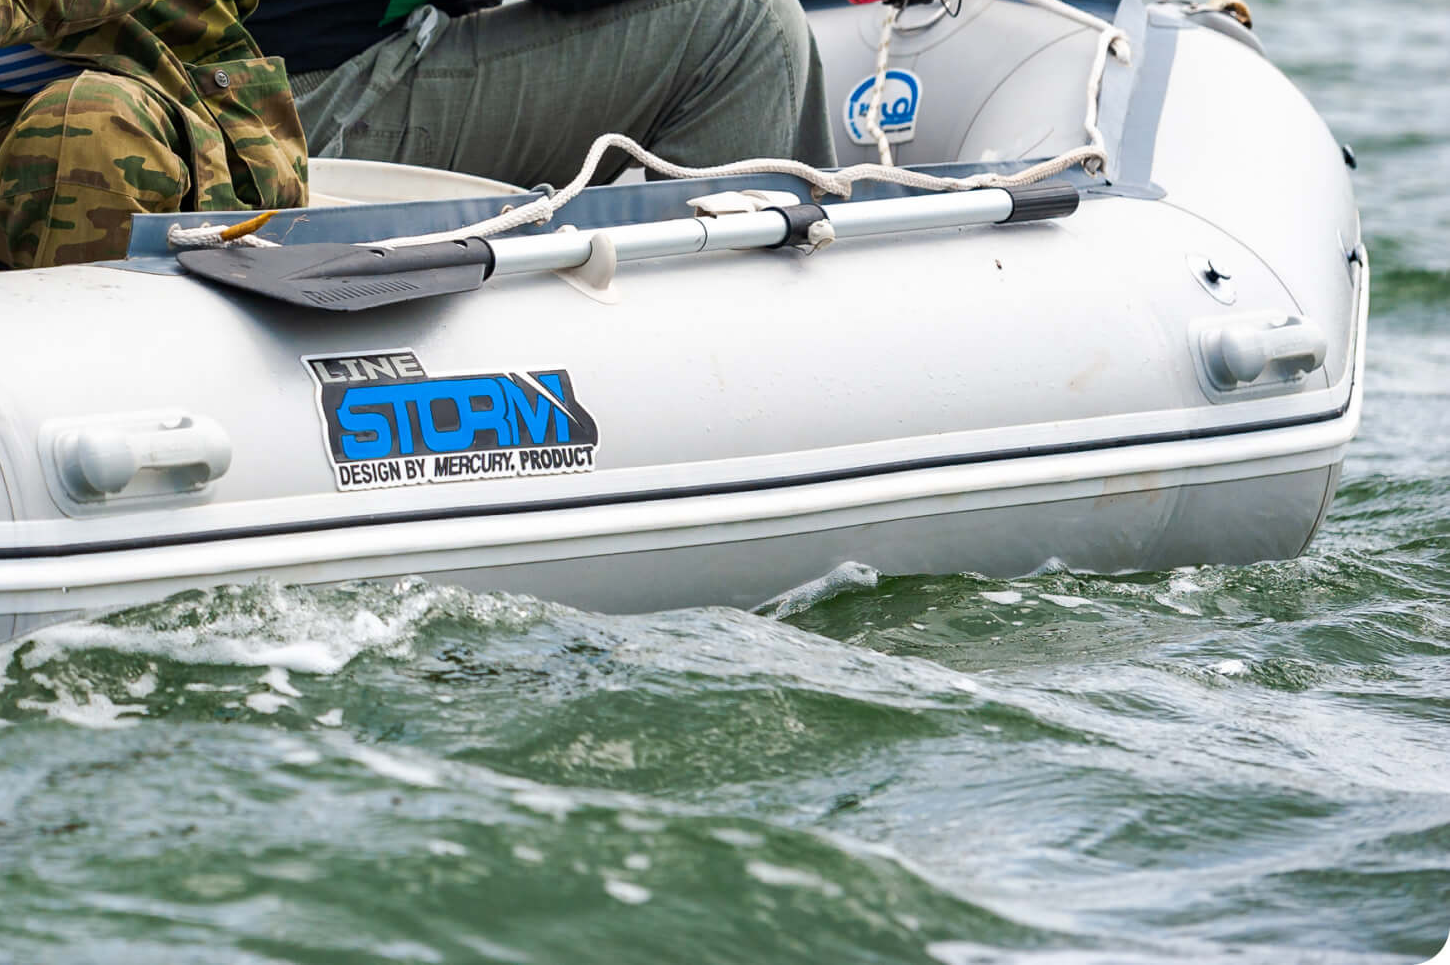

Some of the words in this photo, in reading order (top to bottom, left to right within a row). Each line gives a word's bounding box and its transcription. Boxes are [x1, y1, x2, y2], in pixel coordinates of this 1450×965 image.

[312, 355, 425, 383] LINE
[336, 373, 571, 460] STORM
[339, 460, 401, 486] DESIGN
[405, 458, 427, 479] BY
[519, 445, 595, 471] PRODUCT
